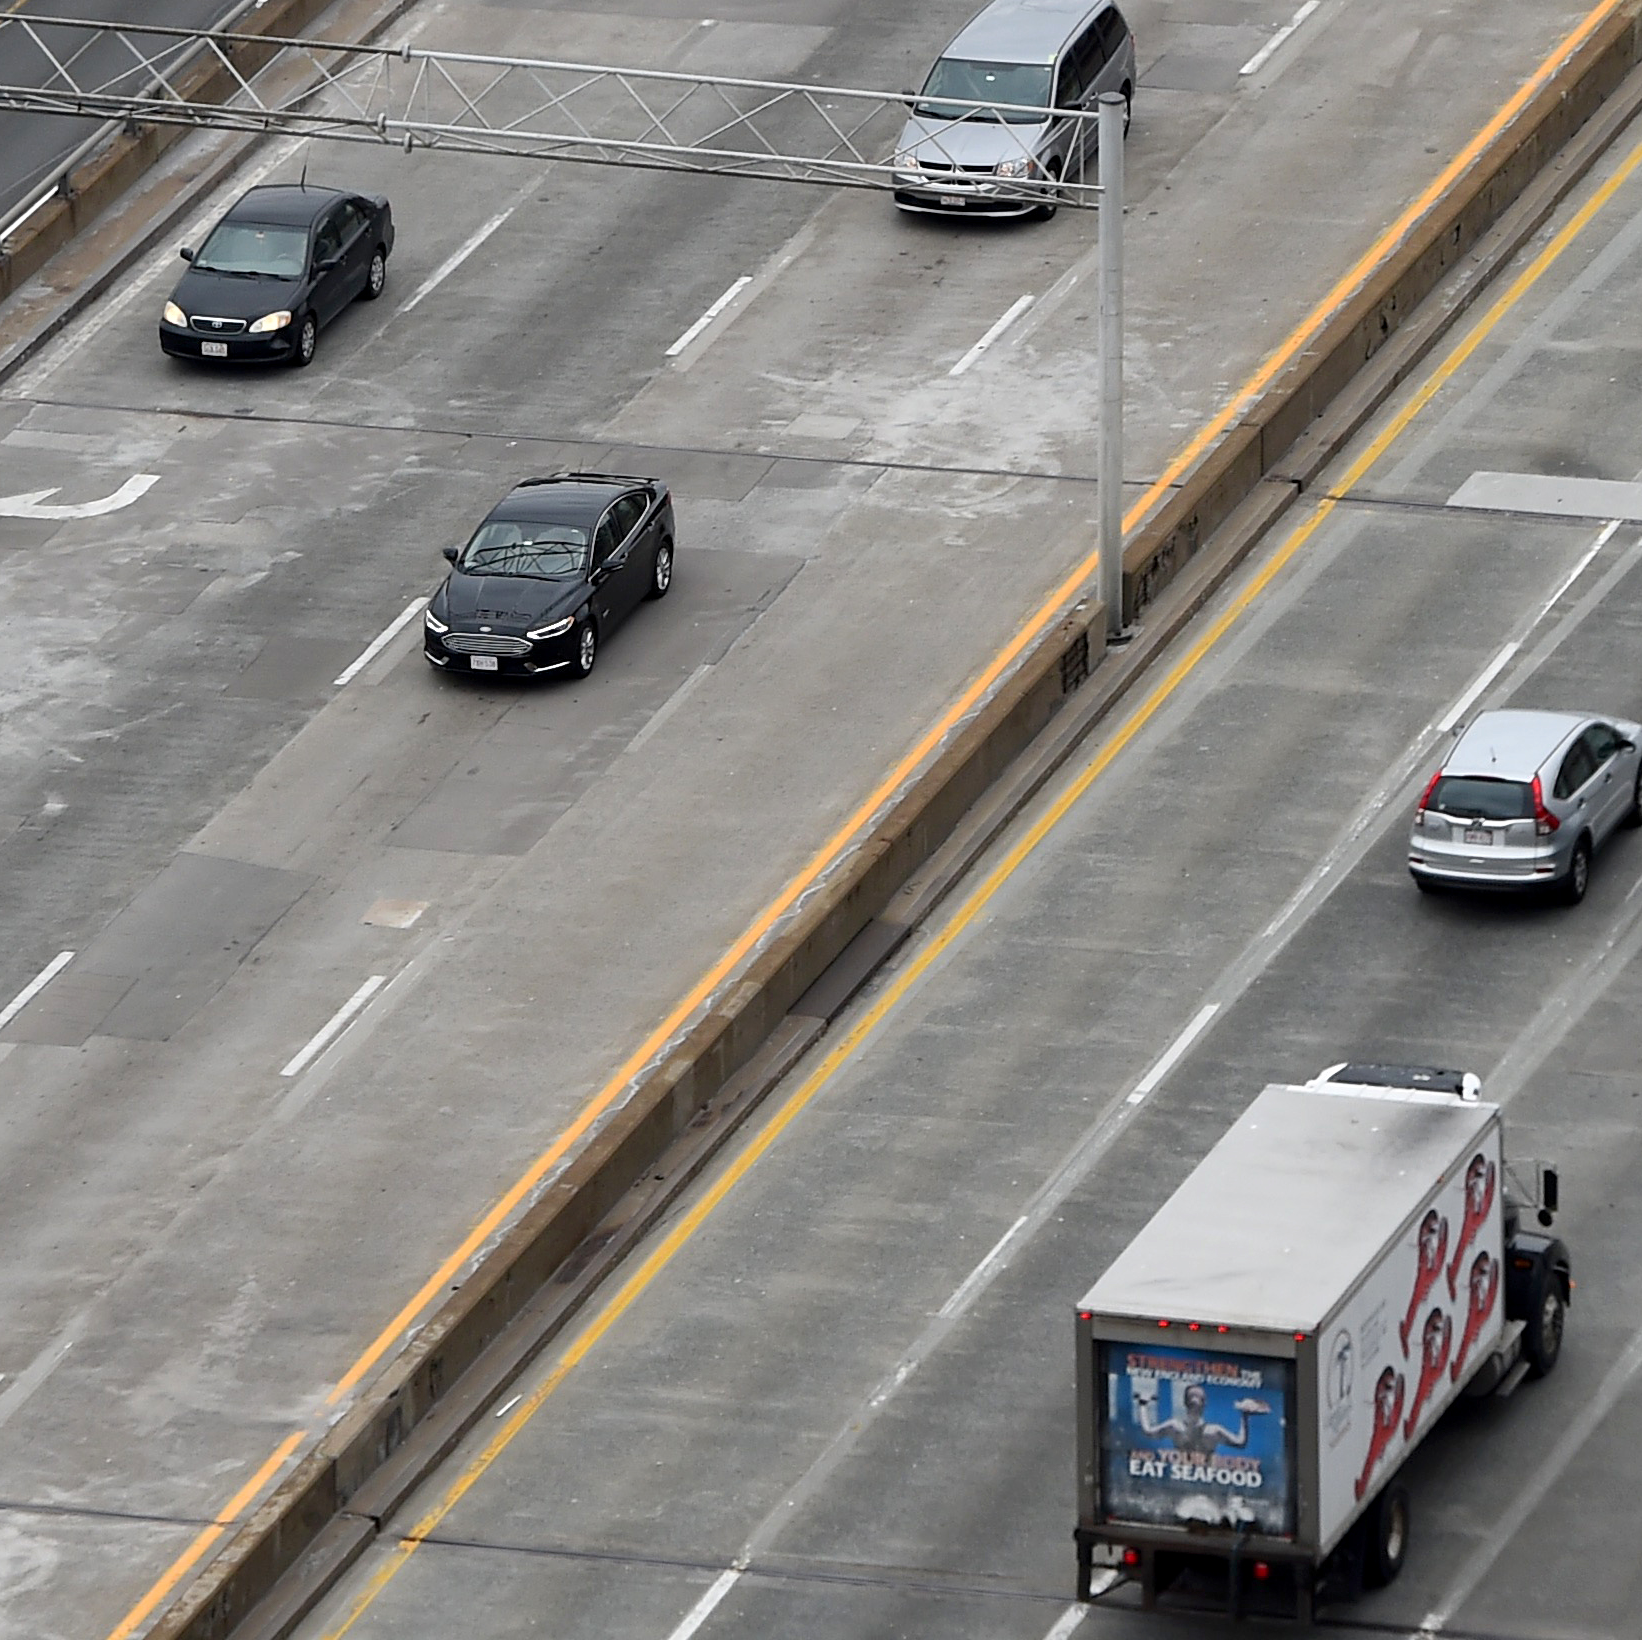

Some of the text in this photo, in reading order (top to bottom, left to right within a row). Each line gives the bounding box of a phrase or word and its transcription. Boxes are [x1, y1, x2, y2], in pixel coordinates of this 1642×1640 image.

[1127, 1354, 1239, 1378] STRENGTHEN
[1158, 1449, 1207, 1465] YOUR
[1211, 1454, 1261, 1471] BODY
[1129, 1459, 1262, 1488] EAT SEAFOOD
